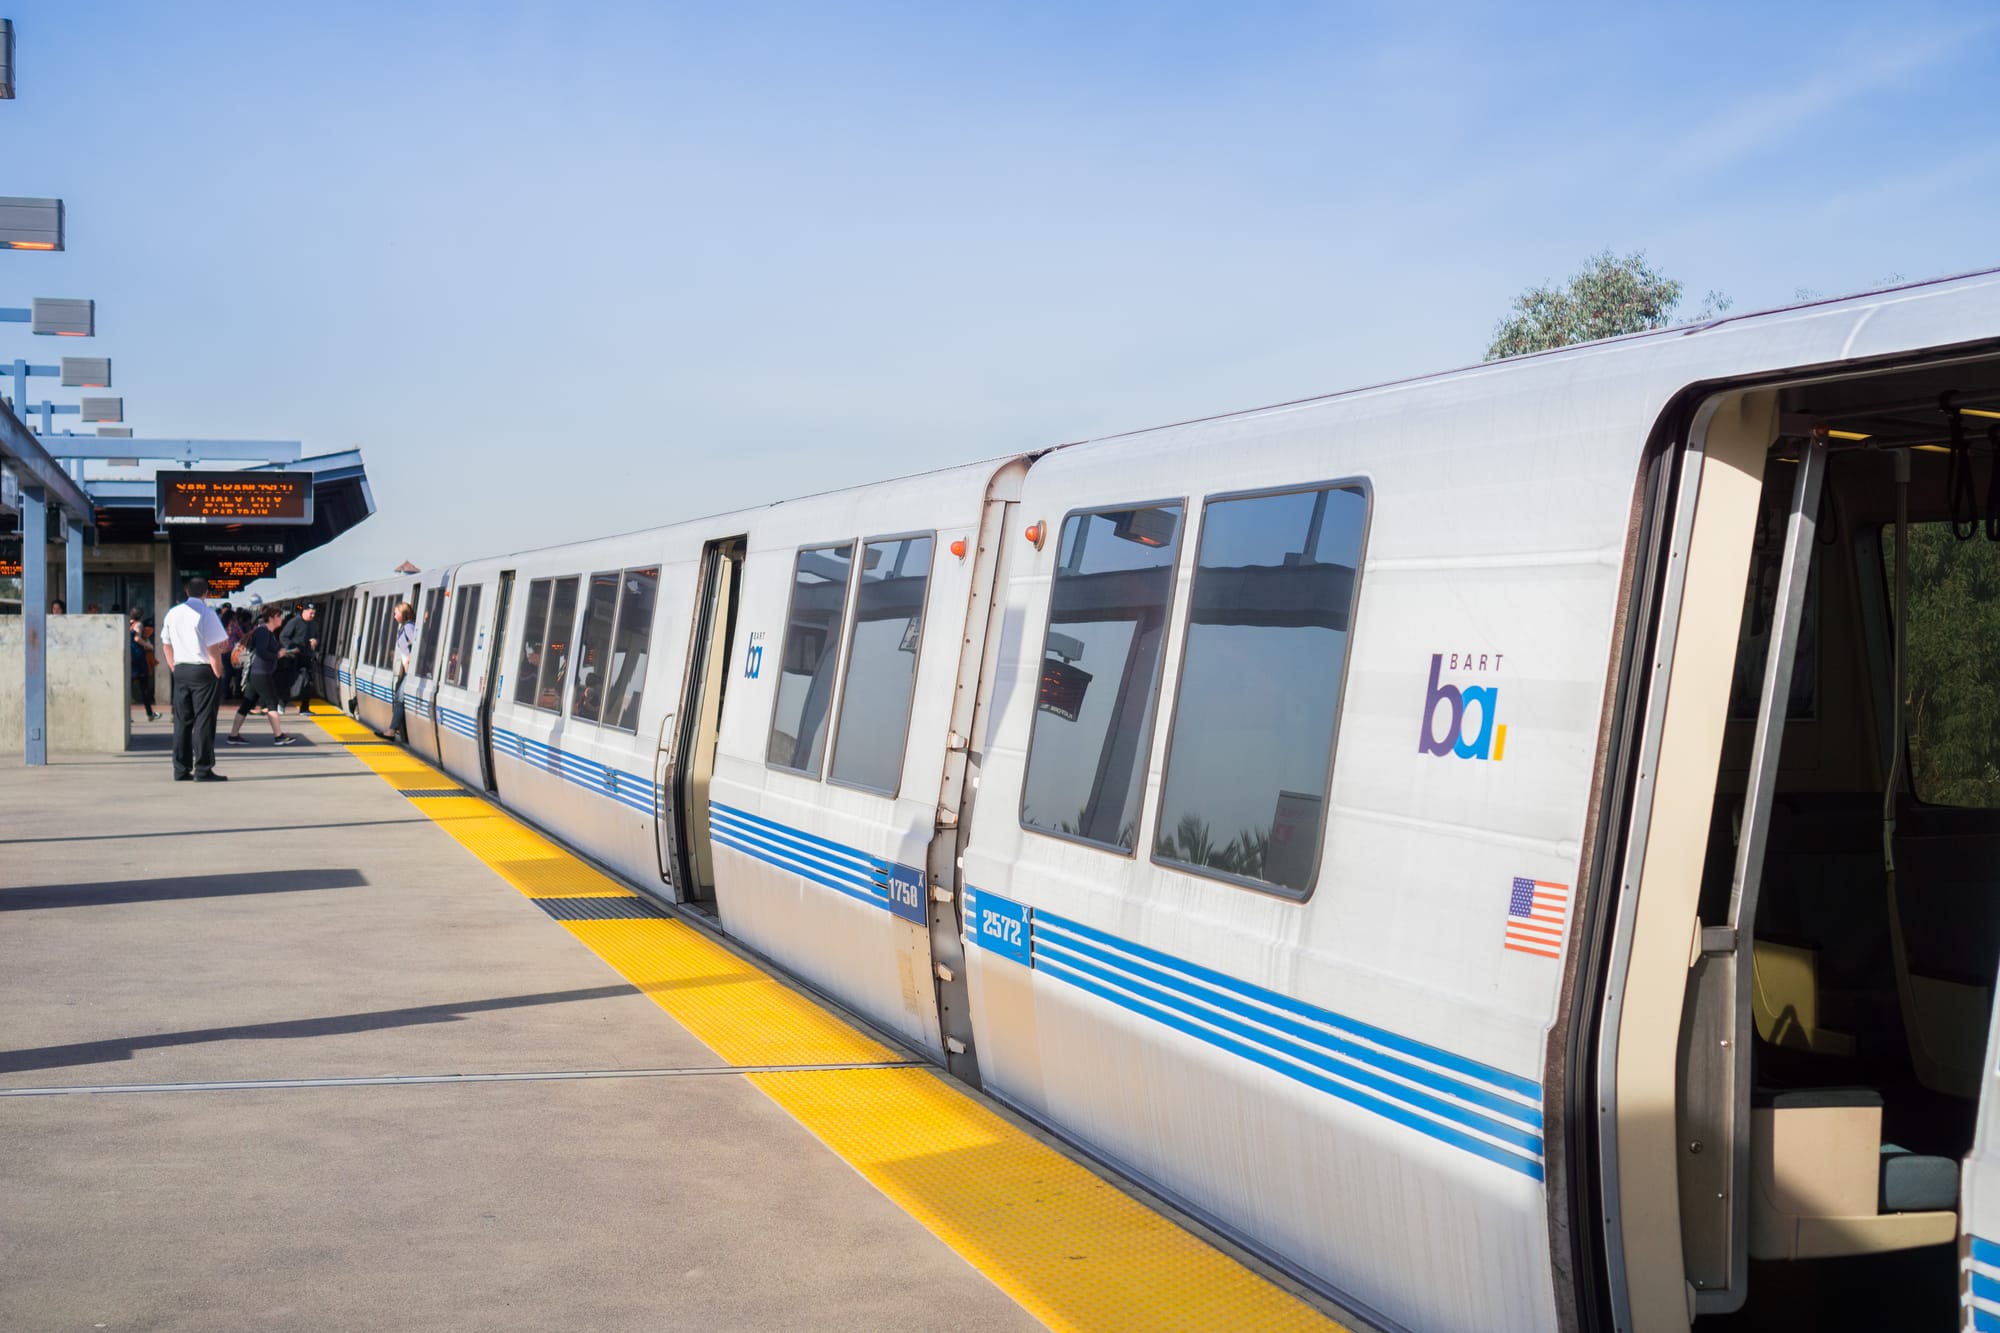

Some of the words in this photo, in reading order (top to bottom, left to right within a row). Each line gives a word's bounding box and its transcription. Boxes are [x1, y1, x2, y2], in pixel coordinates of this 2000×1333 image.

[1449, 653, 1503, 671] BART
[888, 879, 918, 908] 1758
[982, 909, 1022, 947] 2572
